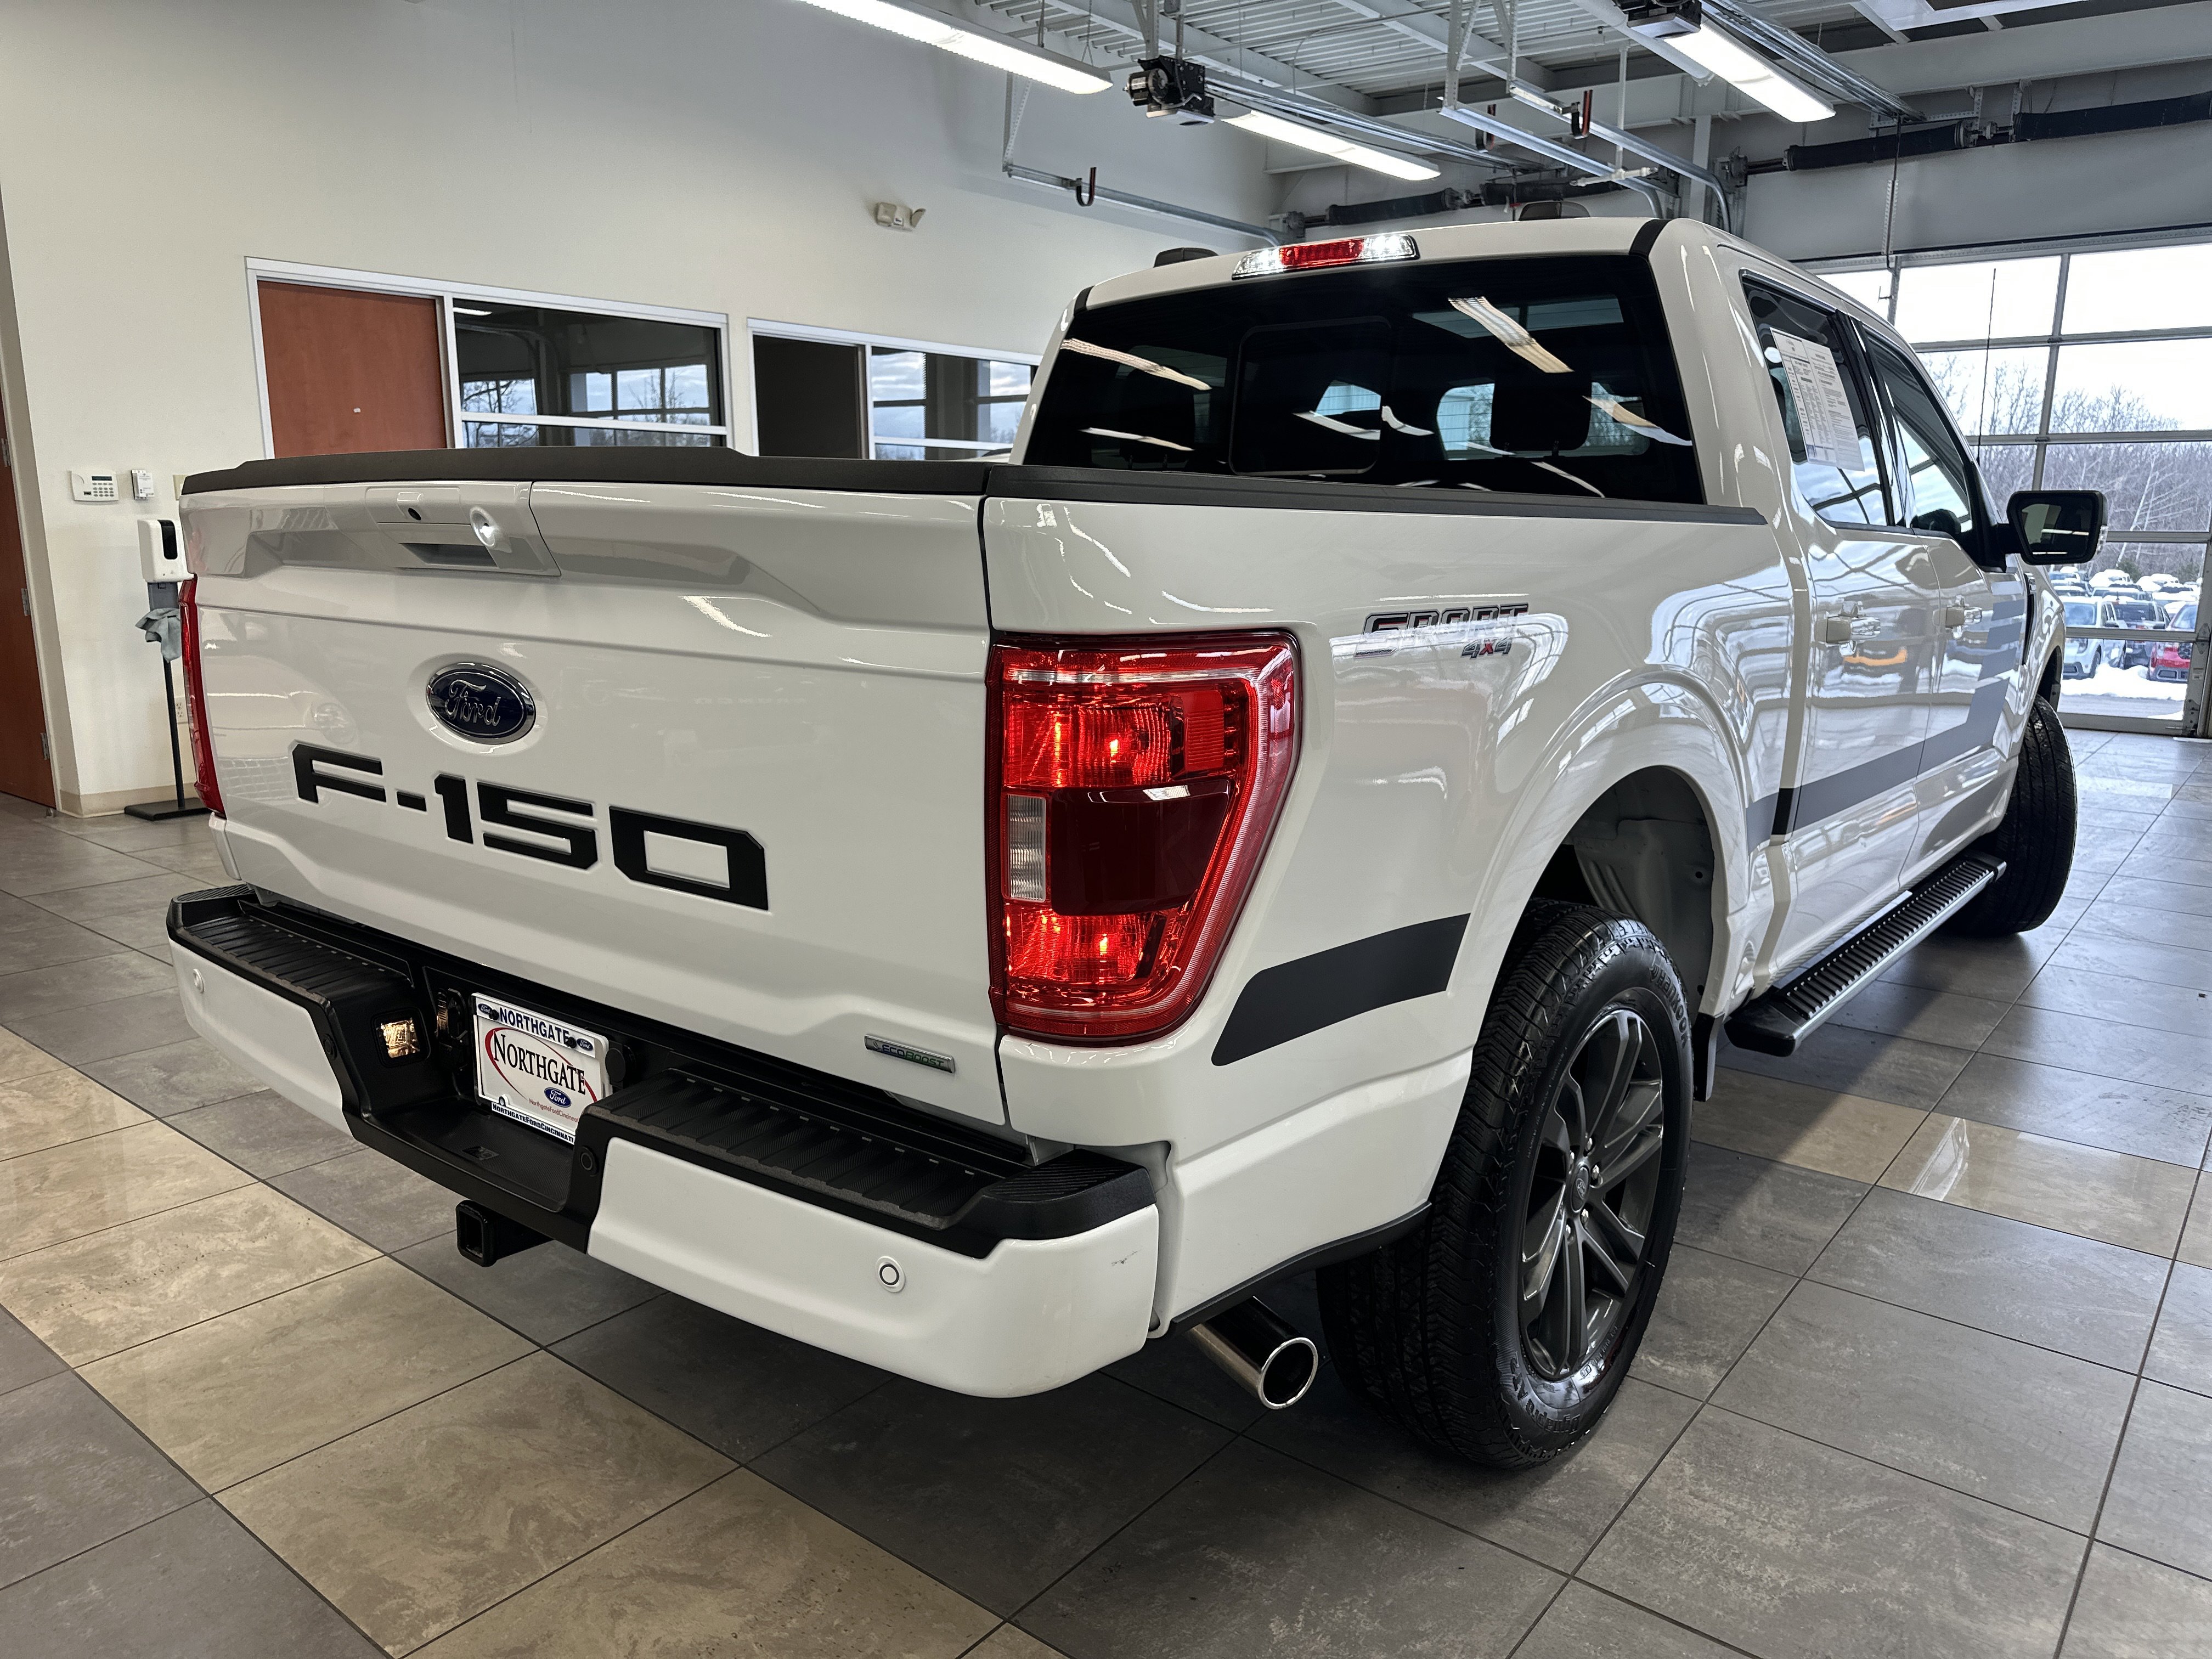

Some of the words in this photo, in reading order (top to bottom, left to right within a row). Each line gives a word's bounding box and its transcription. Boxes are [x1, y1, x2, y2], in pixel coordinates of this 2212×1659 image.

[444, 679, 501, 727] Ford
[292, 742, 770, 912] F-150
[499, 1006, 569, 1045] NORTHGATE
[493, 1030, 586, 1096] NORTHGATE
[882, 1044, 945, 1067] ECOBOOST
[549, 1089, 566, 1105] Ford
